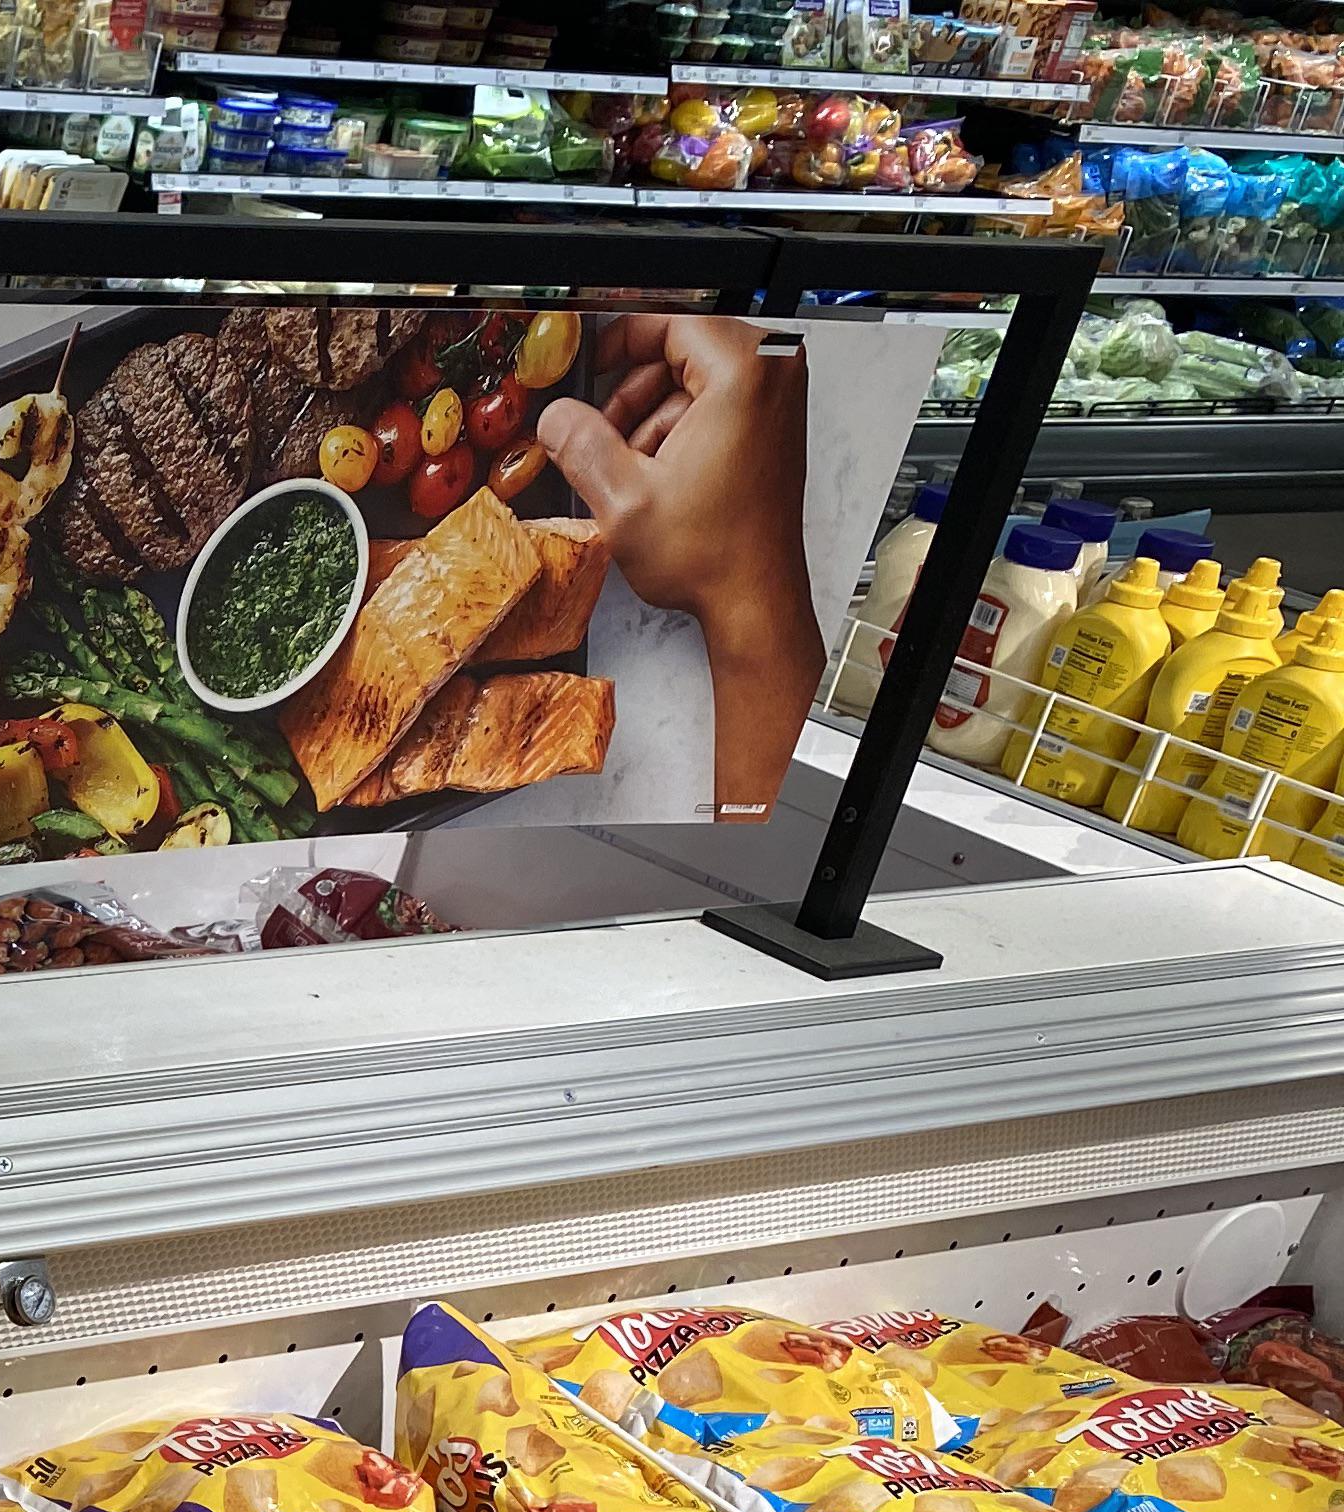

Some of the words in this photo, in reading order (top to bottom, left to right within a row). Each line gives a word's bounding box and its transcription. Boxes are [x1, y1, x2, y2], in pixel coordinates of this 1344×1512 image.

[629, 1322, 698, 1386] PIZZA
[1056, 1388, 1238, 1450] Totino's
[1121, 1432, 1196, 1466] PIZZA
[1198, 1414, 1269, 1446] ROLLS
[24, 1456, 58, 1485] 50
[191, 1442, 268, 1477] PIZZA
